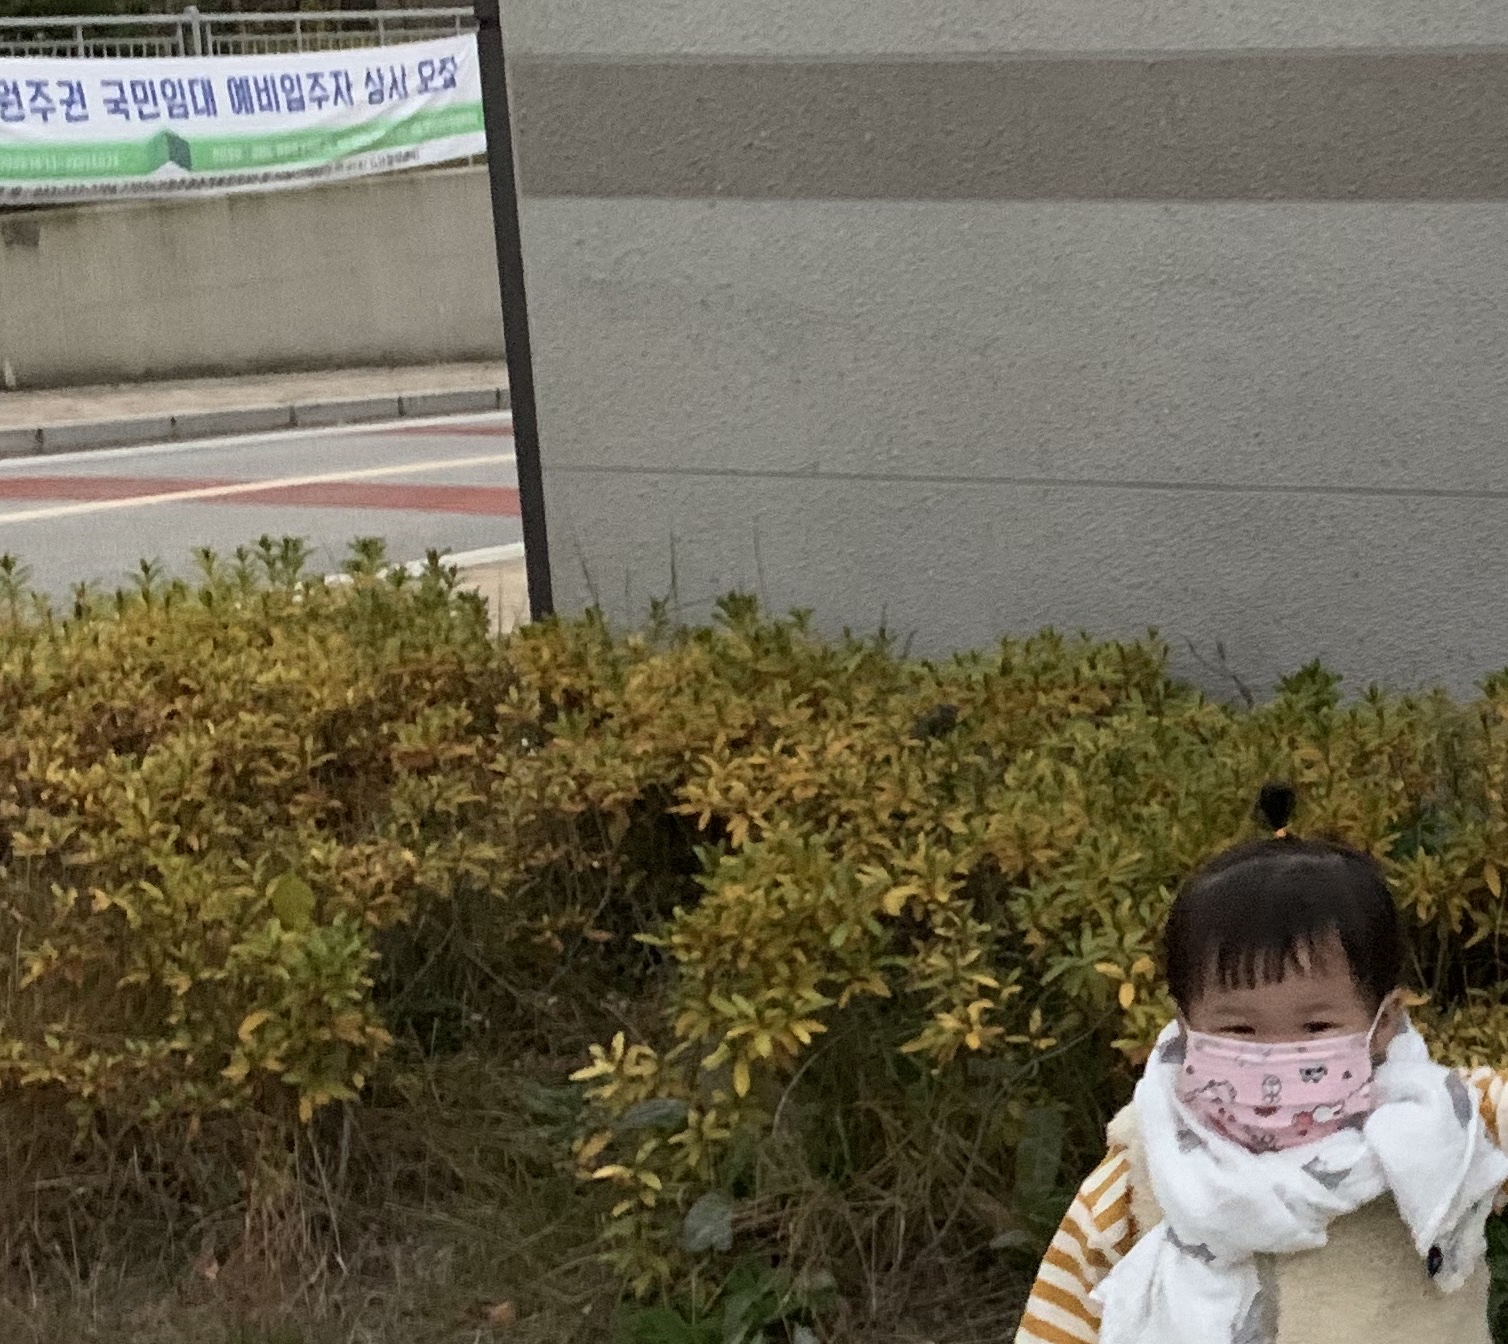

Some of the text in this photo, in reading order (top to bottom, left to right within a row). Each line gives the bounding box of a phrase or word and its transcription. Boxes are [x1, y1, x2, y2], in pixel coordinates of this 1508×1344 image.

[100, 77, 217, 121] 국민임대
[226, 68, 354, 115] 예비입주자
[365, 64, 409, 105] 상시
[417, 54, 457, 94] 모집
